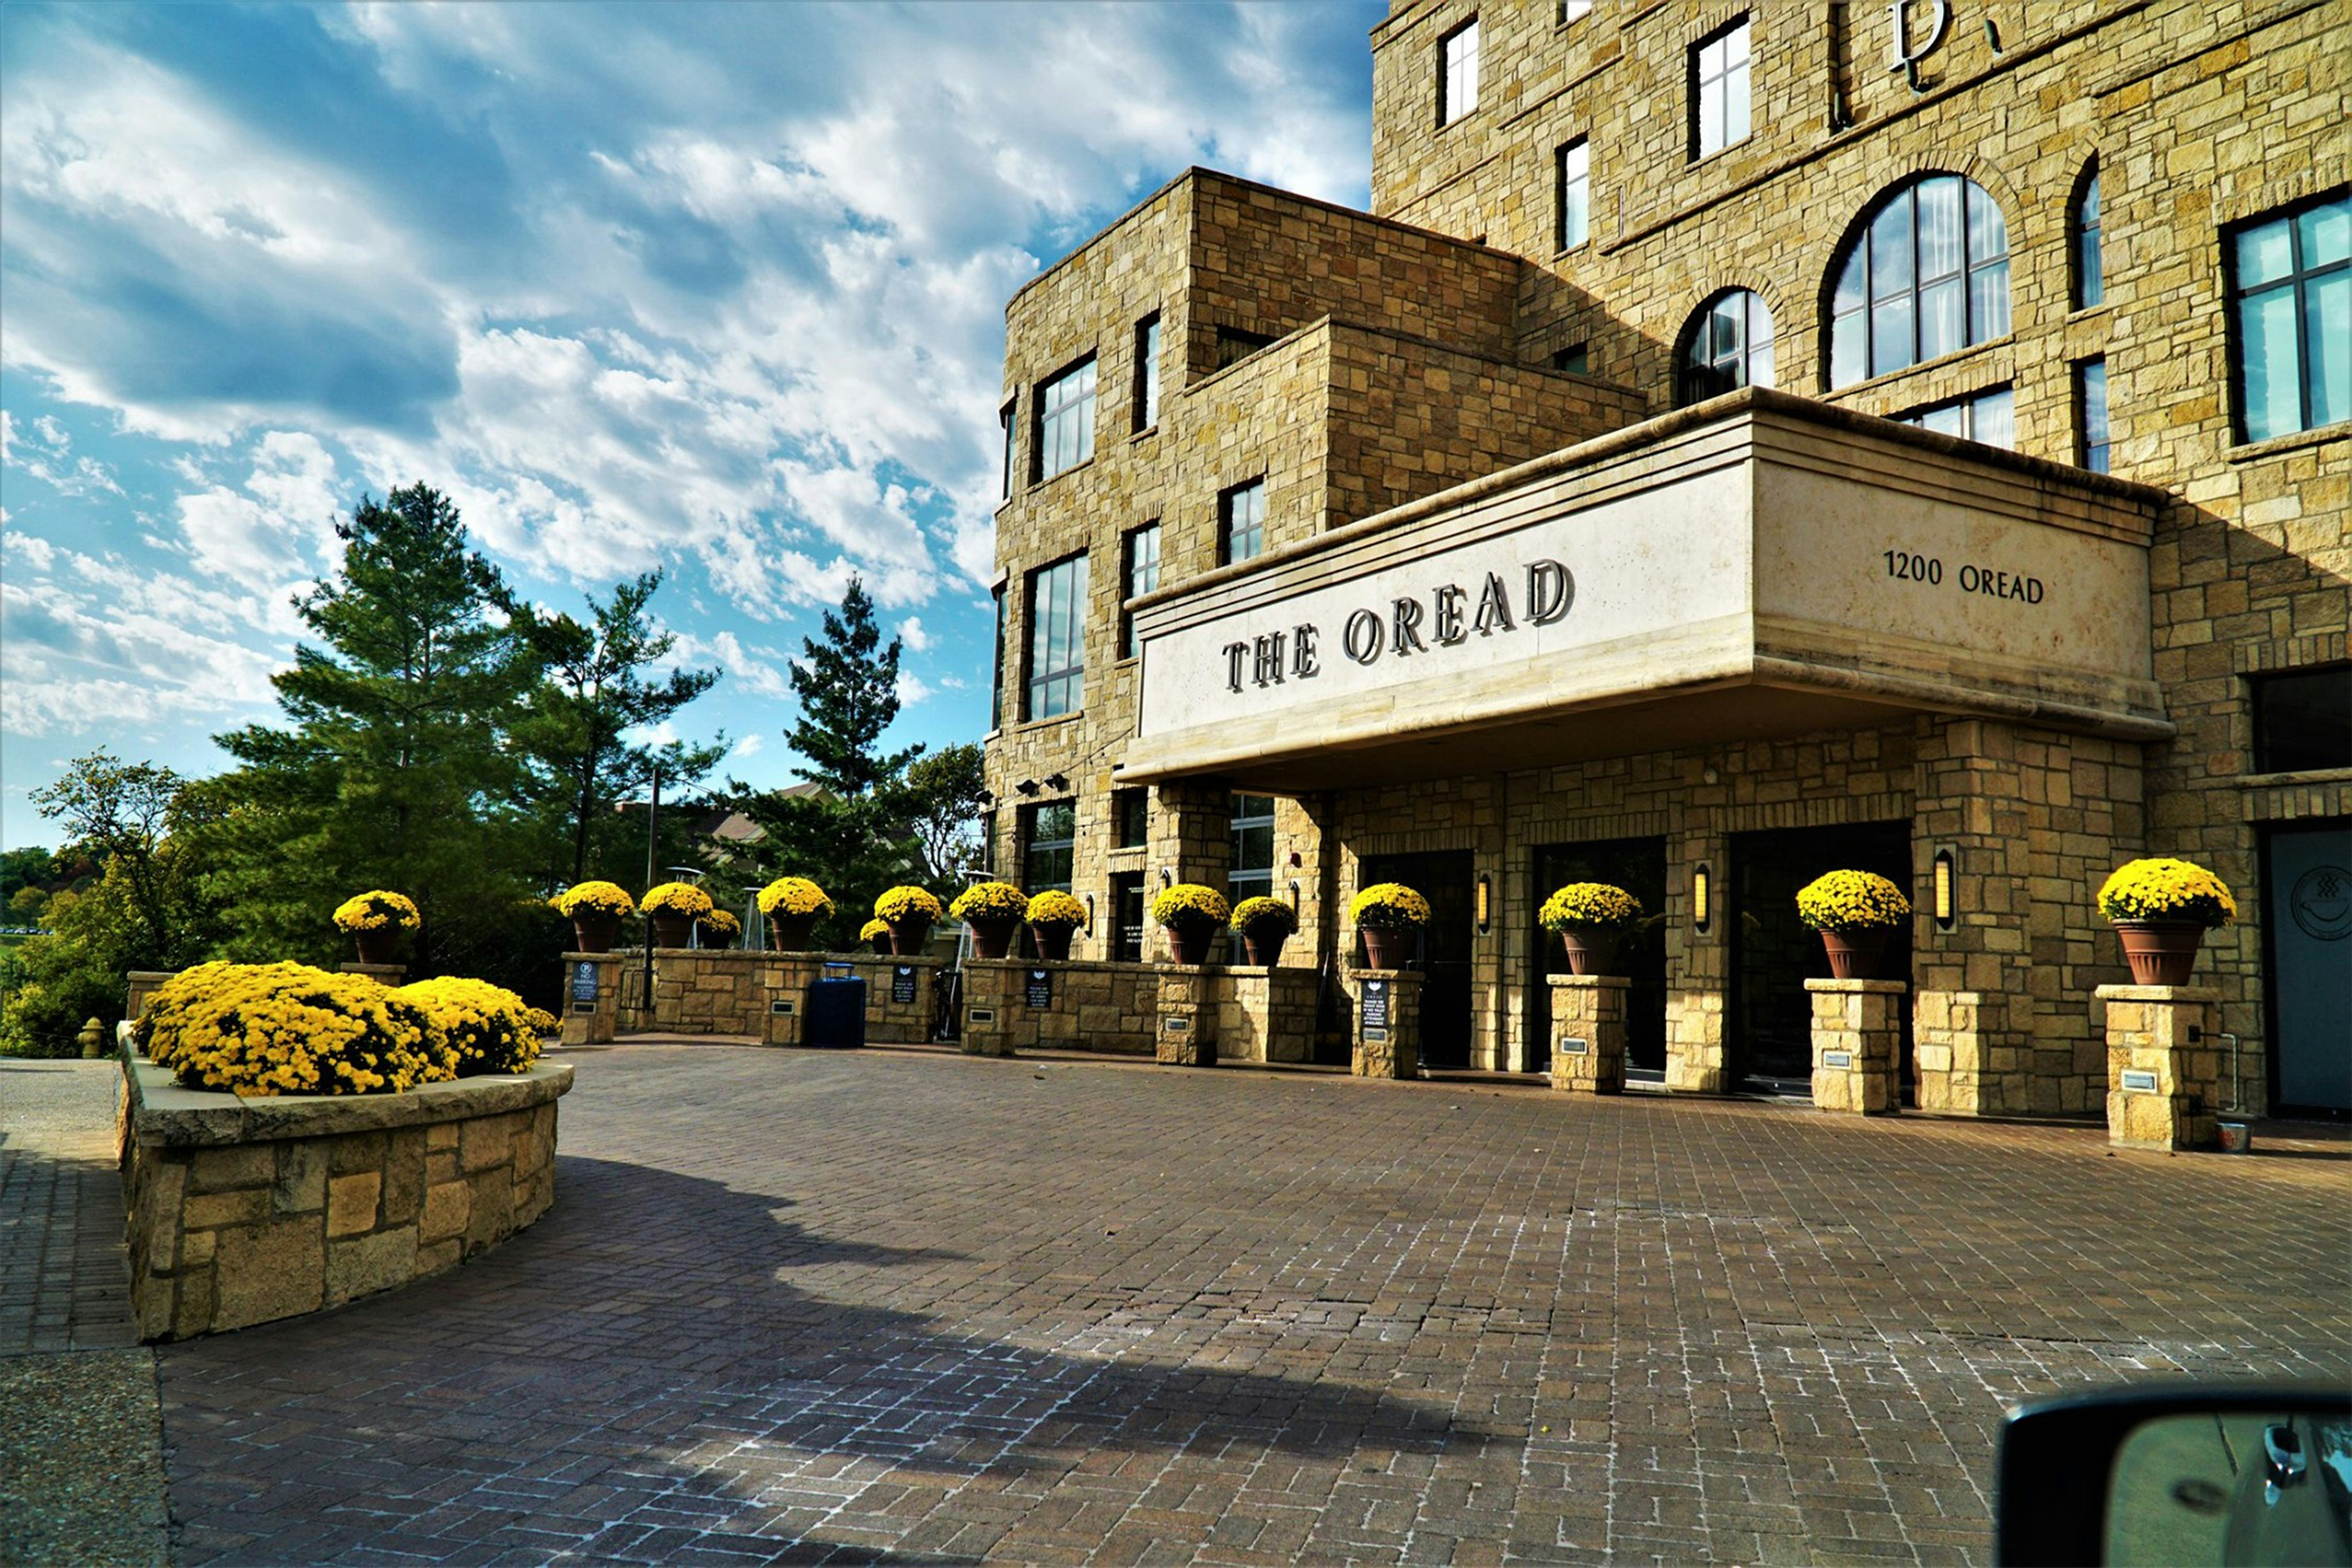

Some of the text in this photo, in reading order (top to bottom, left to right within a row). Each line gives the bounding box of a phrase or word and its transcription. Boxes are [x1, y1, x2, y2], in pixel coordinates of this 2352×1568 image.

[1887, 0, 1945, 73] D
[1884, 549, 2044, 604] 1200 OREAD
[1222, 558, 1571, 691] THE OREAD
